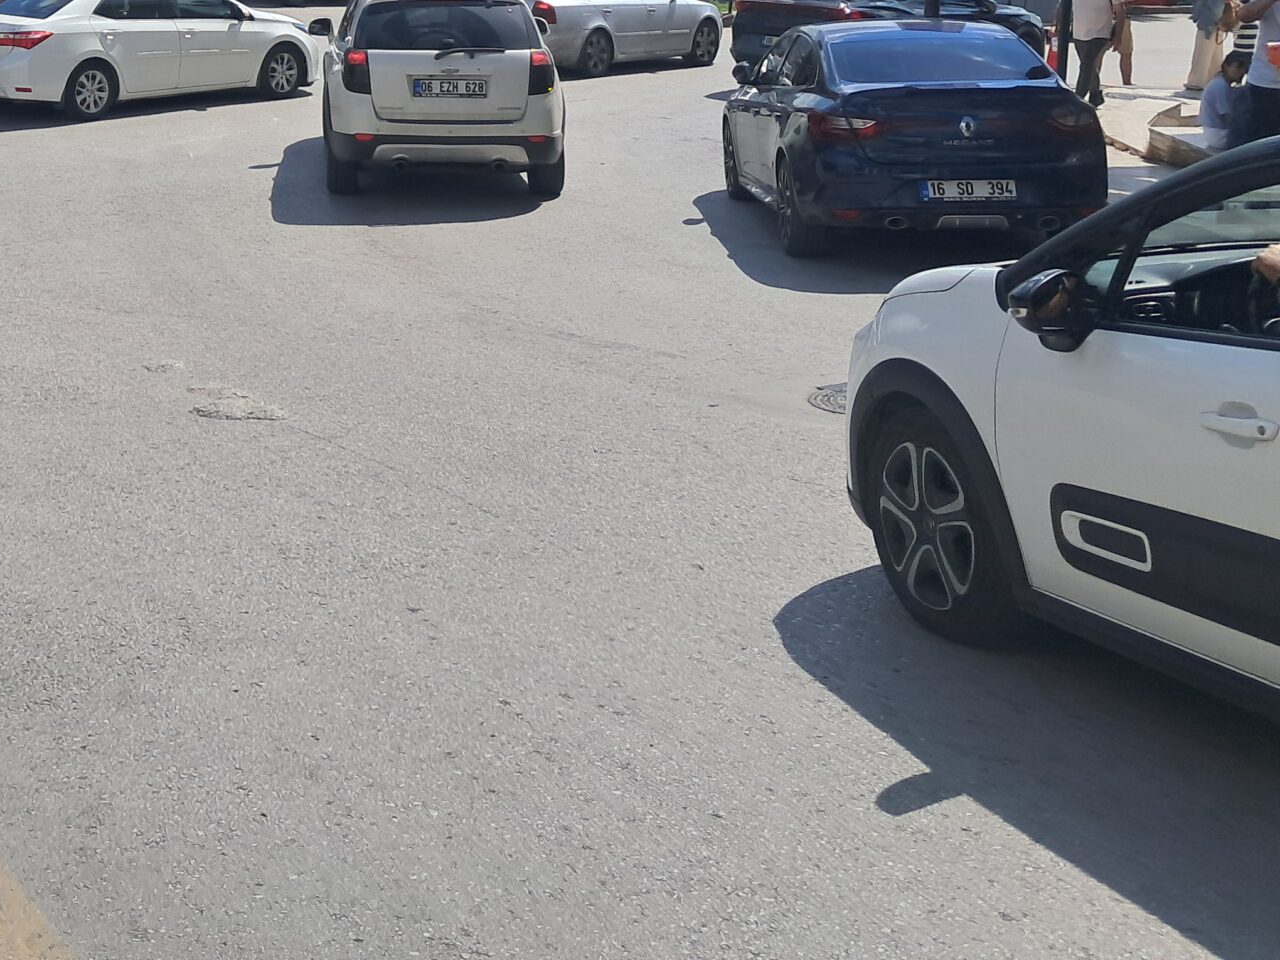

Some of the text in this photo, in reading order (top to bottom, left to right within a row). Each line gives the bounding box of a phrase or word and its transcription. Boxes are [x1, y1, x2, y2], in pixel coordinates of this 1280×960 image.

[421, 81, 484, 93] 06 EZH 628
[930, 181, 1013, 196] 16 SD 394
